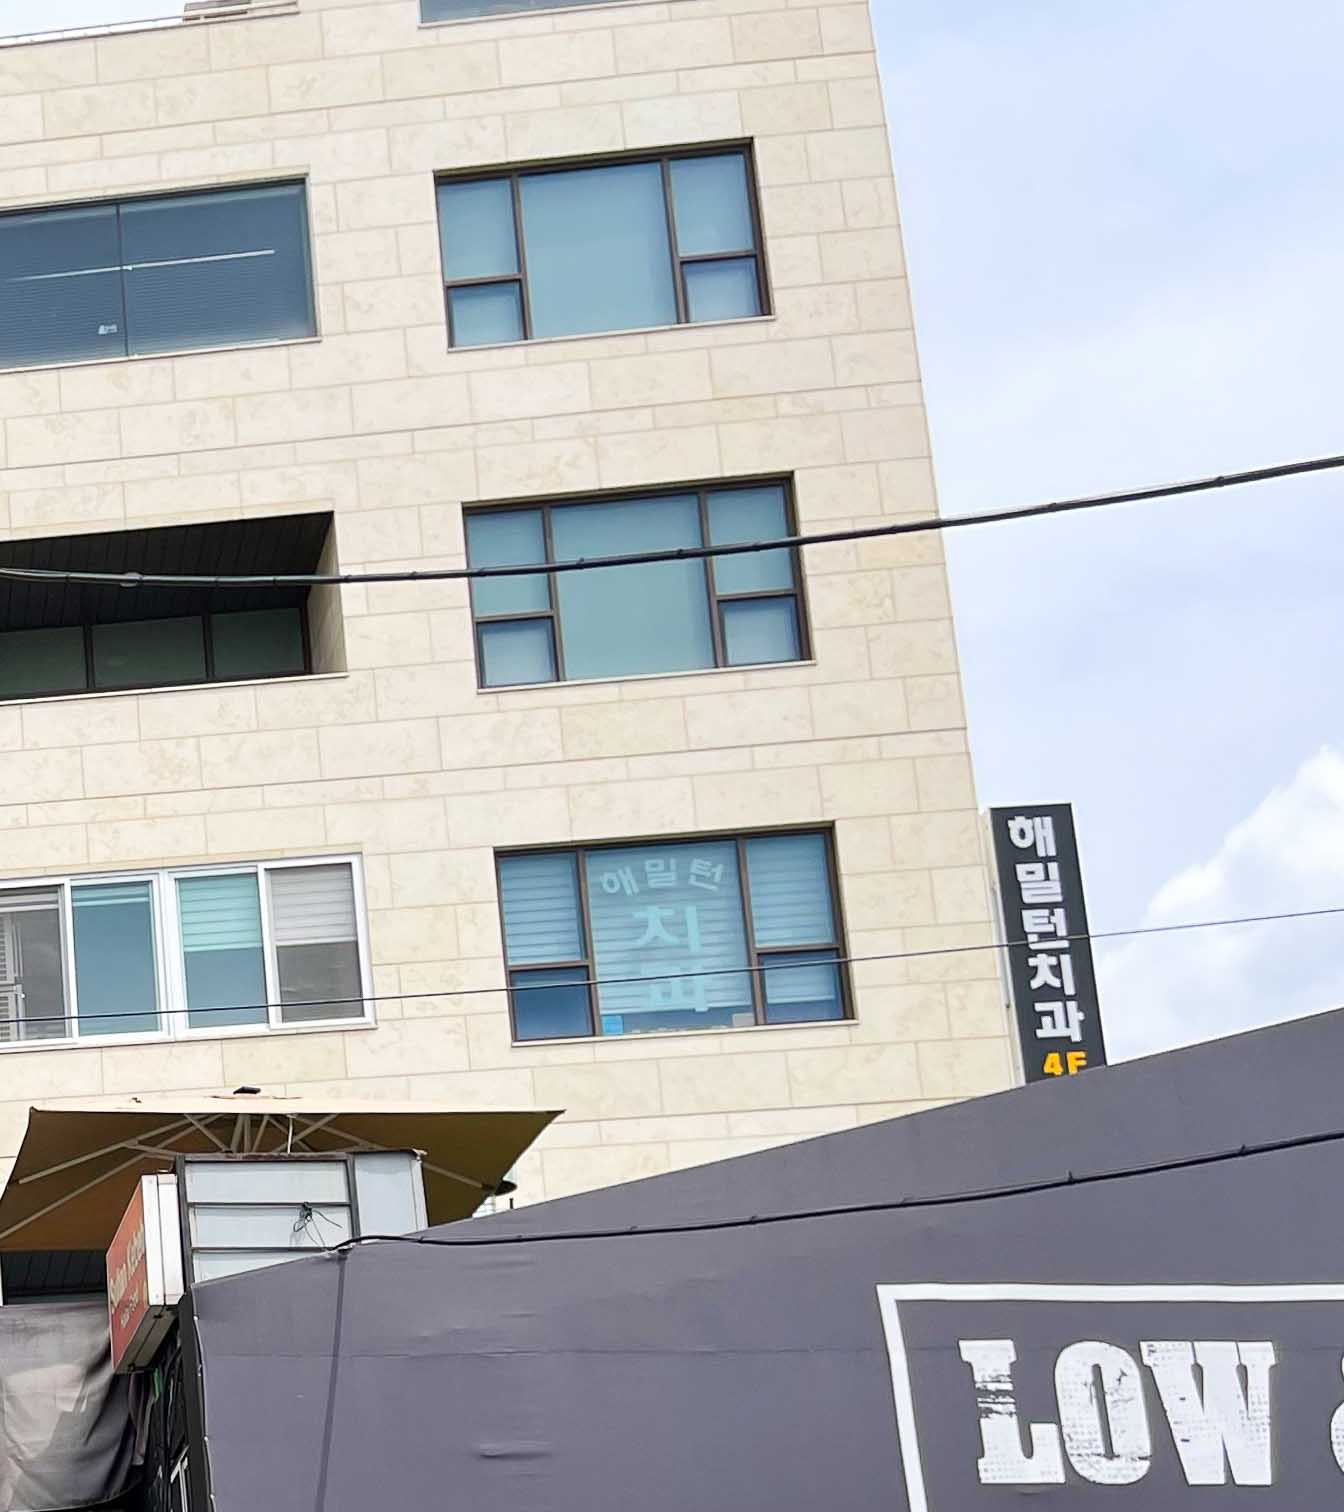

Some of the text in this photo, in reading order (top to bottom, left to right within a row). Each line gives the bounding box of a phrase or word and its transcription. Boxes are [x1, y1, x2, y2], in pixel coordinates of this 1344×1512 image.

[600, 857, 724, 896] 해밀턴
[1008, 816, 1085, 1042] 해밀턴치과
[1043, 1051, 1087, 1076] 4F
[958, 1338, 1277, 1487] LOW
